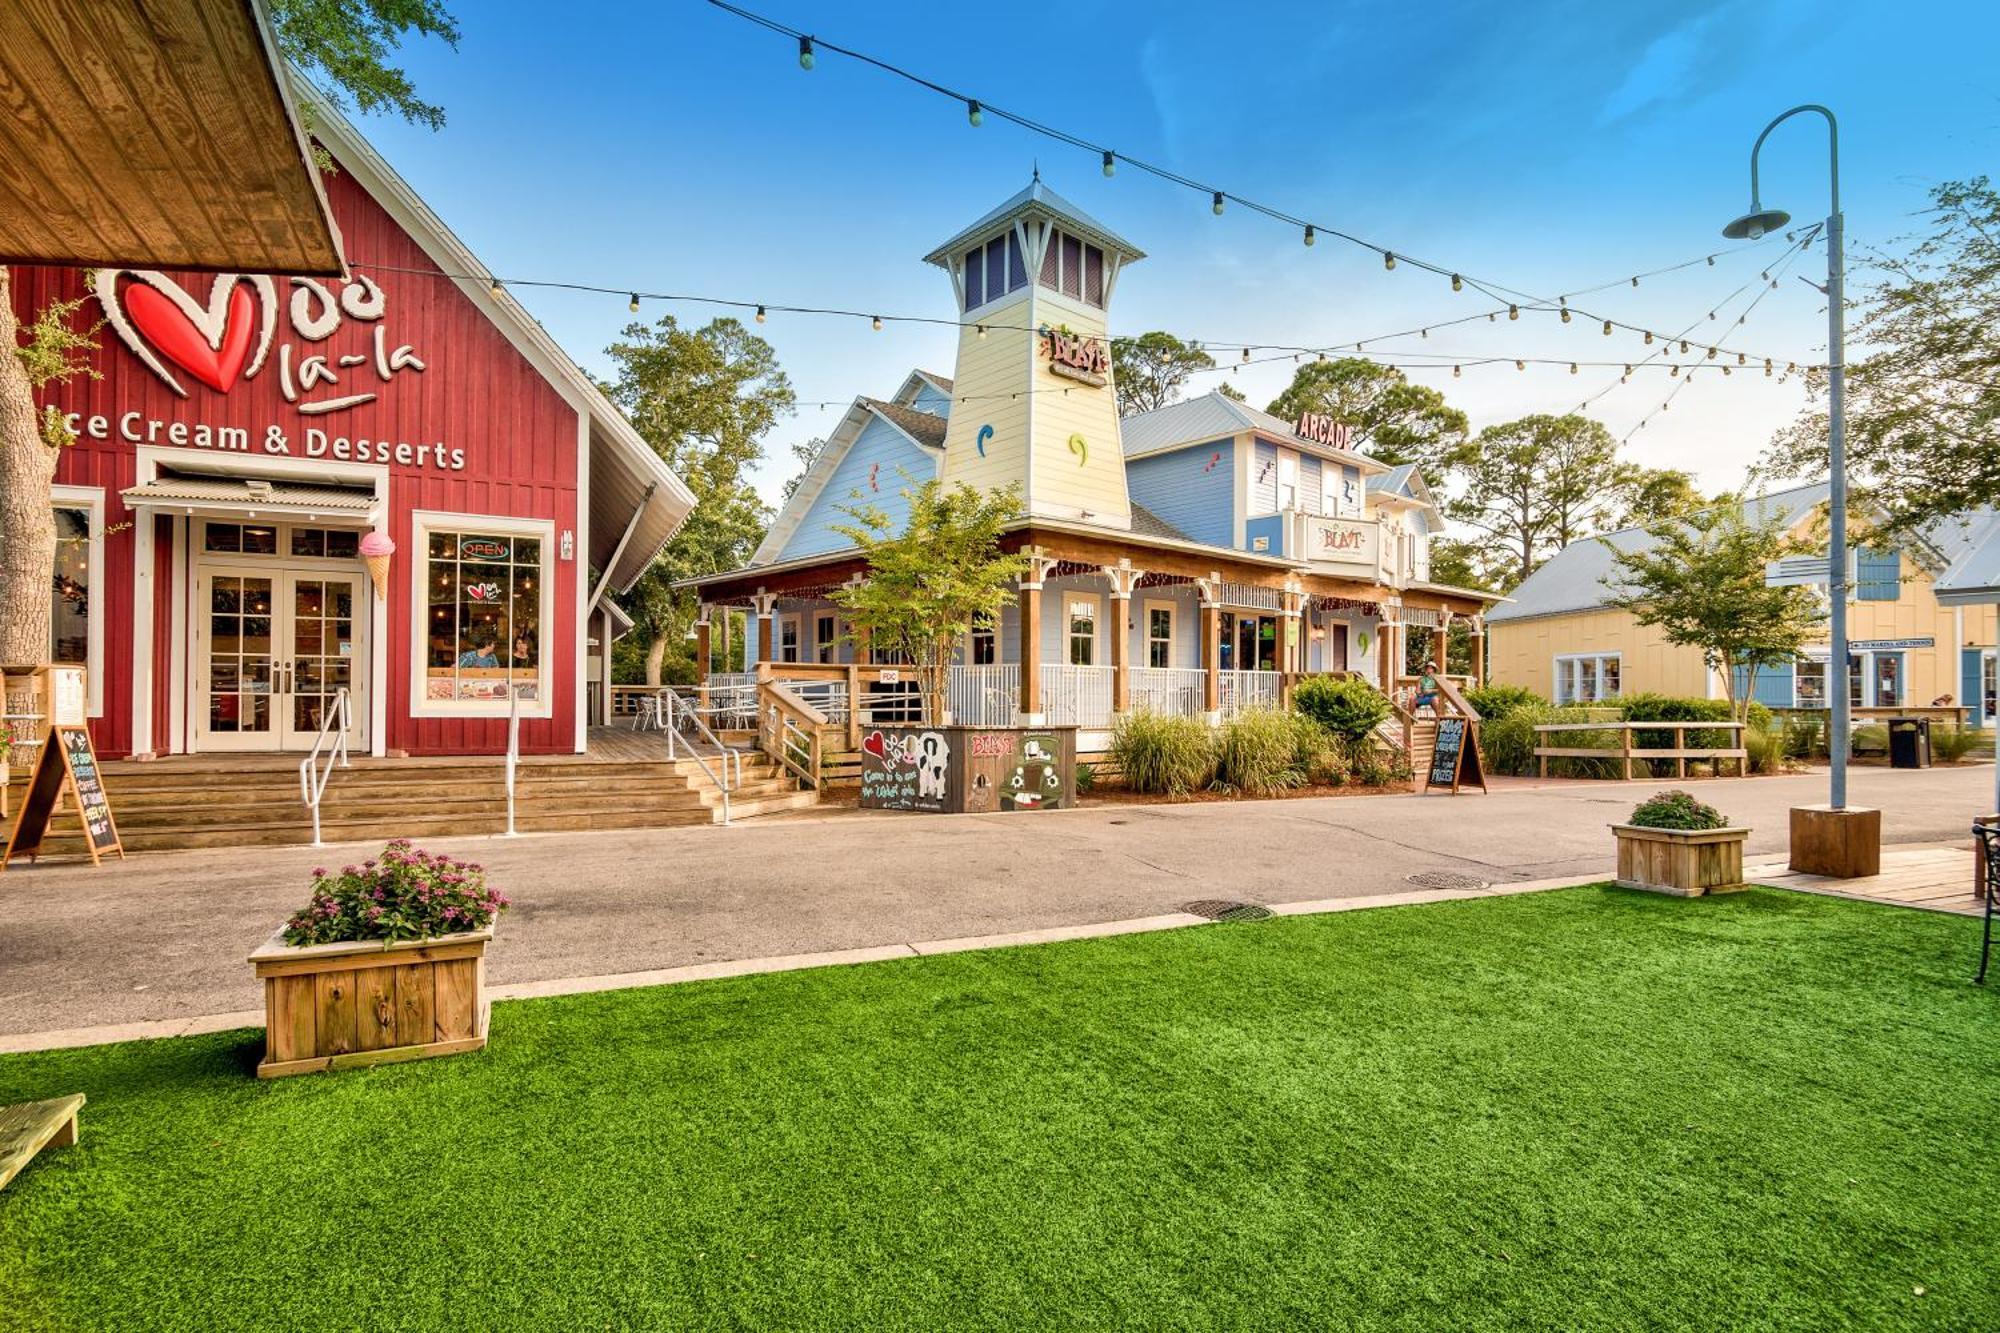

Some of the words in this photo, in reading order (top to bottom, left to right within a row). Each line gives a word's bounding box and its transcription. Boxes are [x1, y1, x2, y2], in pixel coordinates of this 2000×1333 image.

[280, 324, 426, 402] la-la
[120, 411, 248, 450] Cream
[264, 425, 290, 454] &
[306, 428, 465, 470] Desserts
[1299, 411, 1352, 450] ARCADE
[463, 544, 504, 556] OPEN
